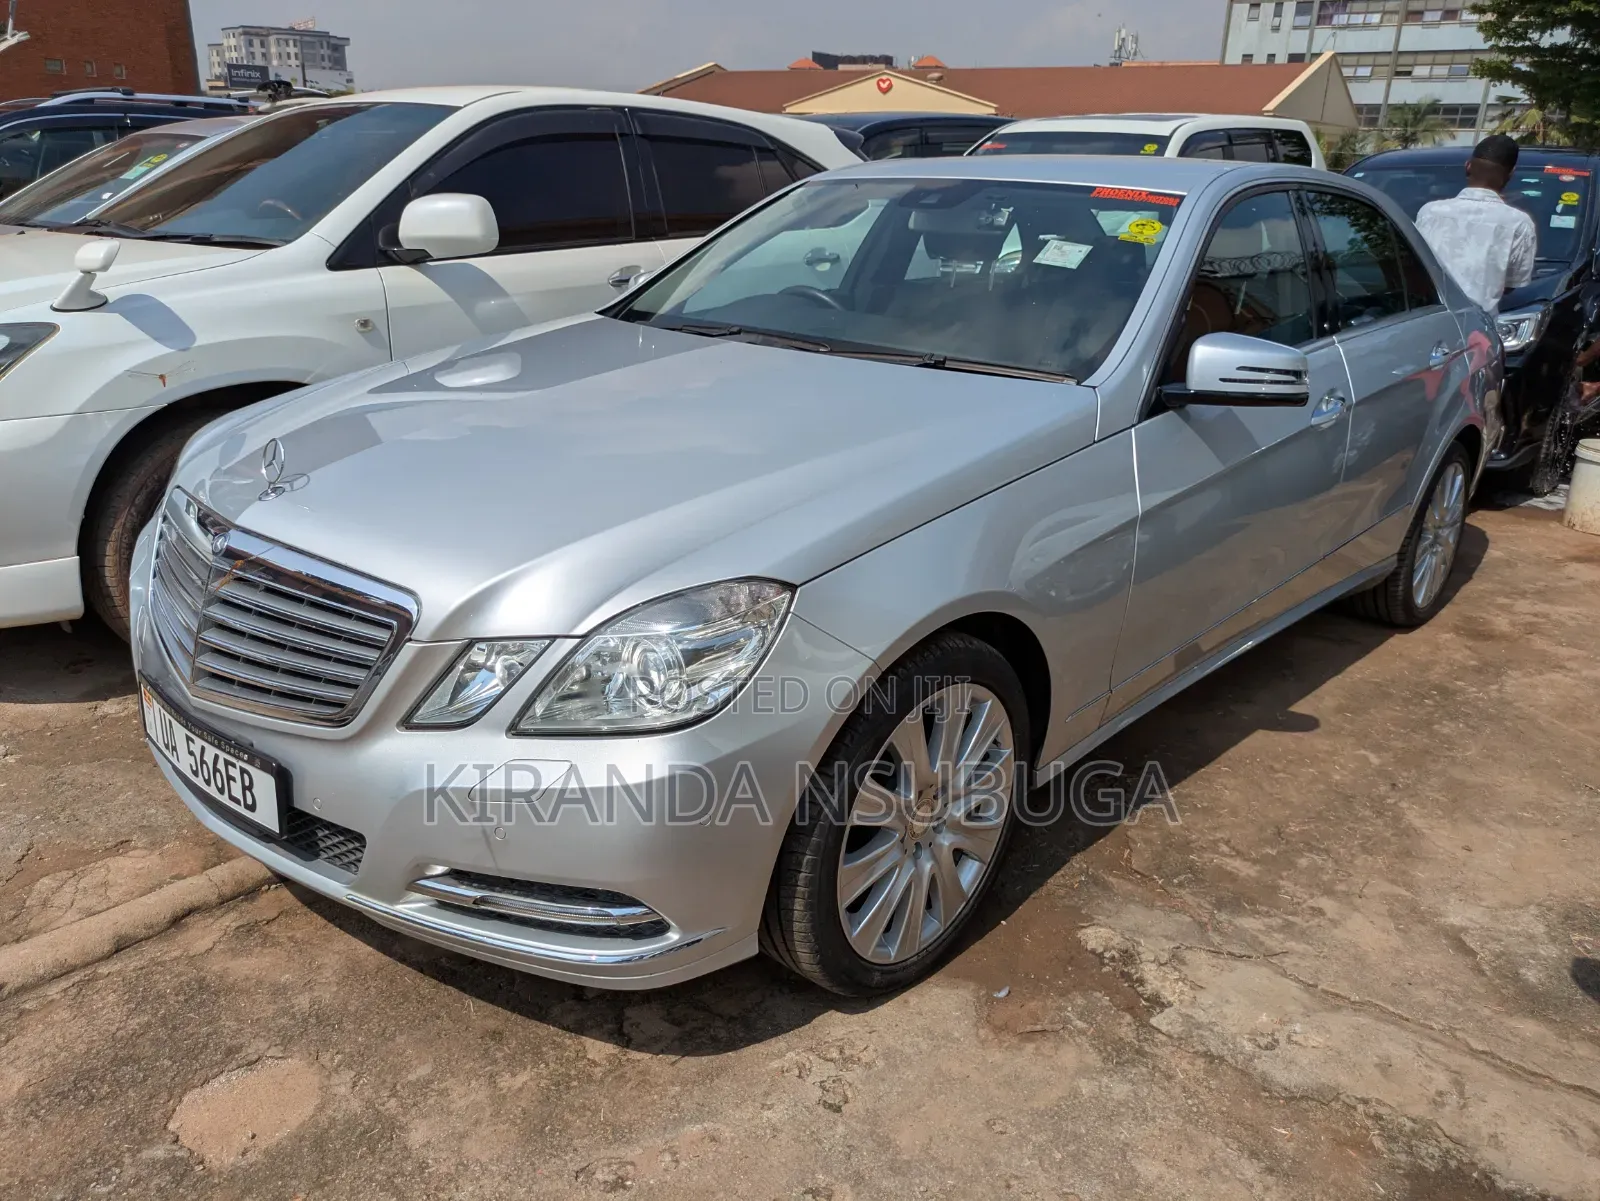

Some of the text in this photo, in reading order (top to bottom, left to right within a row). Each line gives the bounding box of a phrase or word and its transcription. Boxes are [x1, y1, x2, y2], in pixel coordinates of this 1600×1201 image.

[231, 68, 262, 79] Infinix
[1090, 187, 1150, 200] PHOENIX
[203, 731, 219, 746] Safe
[158, 707, 257, 813] UA 566EB
